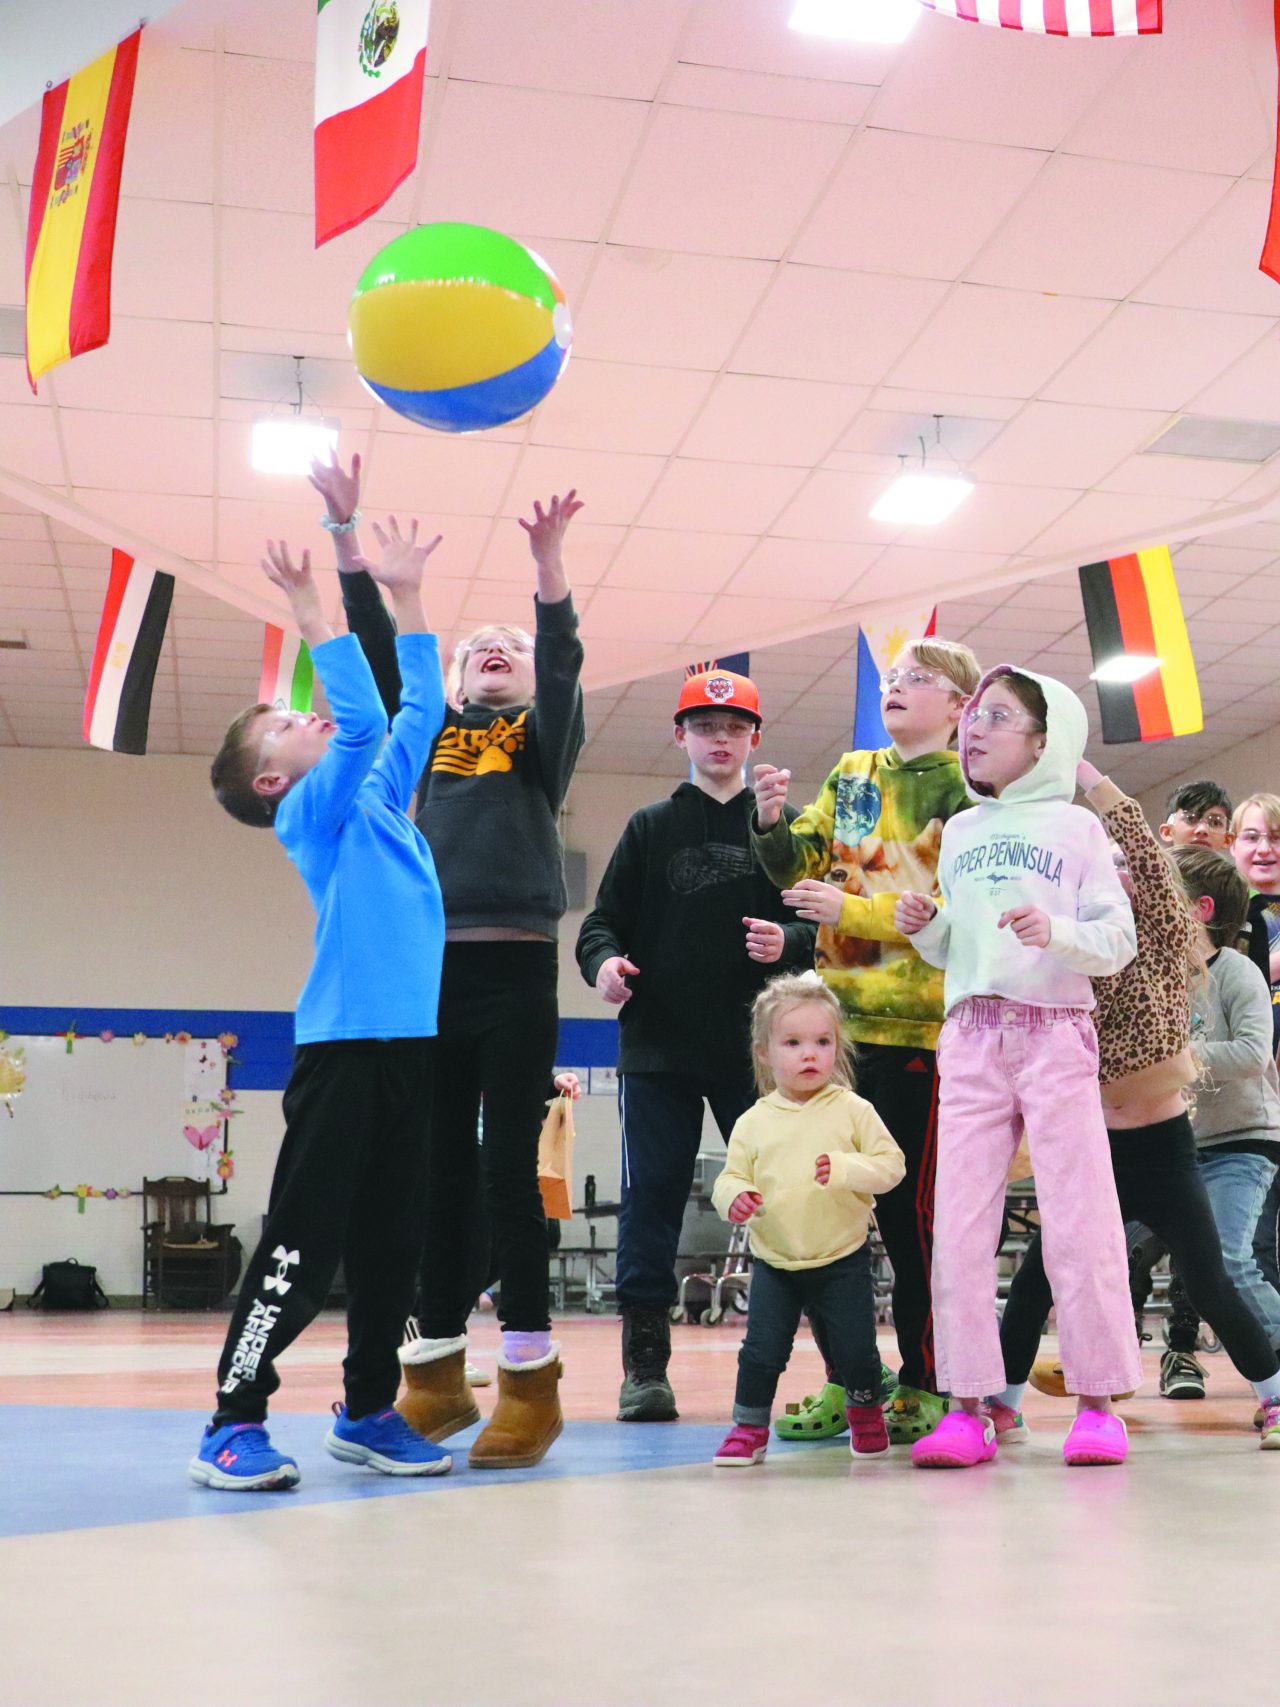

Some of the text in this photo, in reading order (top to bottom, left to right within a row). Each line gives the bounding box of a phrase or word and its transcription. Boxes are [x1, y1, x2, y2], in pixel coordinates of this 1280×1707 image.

[987, 841, 1063, 887] PENINSULA
[220, 1298, 266, 1394] ARMOUR
[242, 1305, 282, 1382] UNDER
